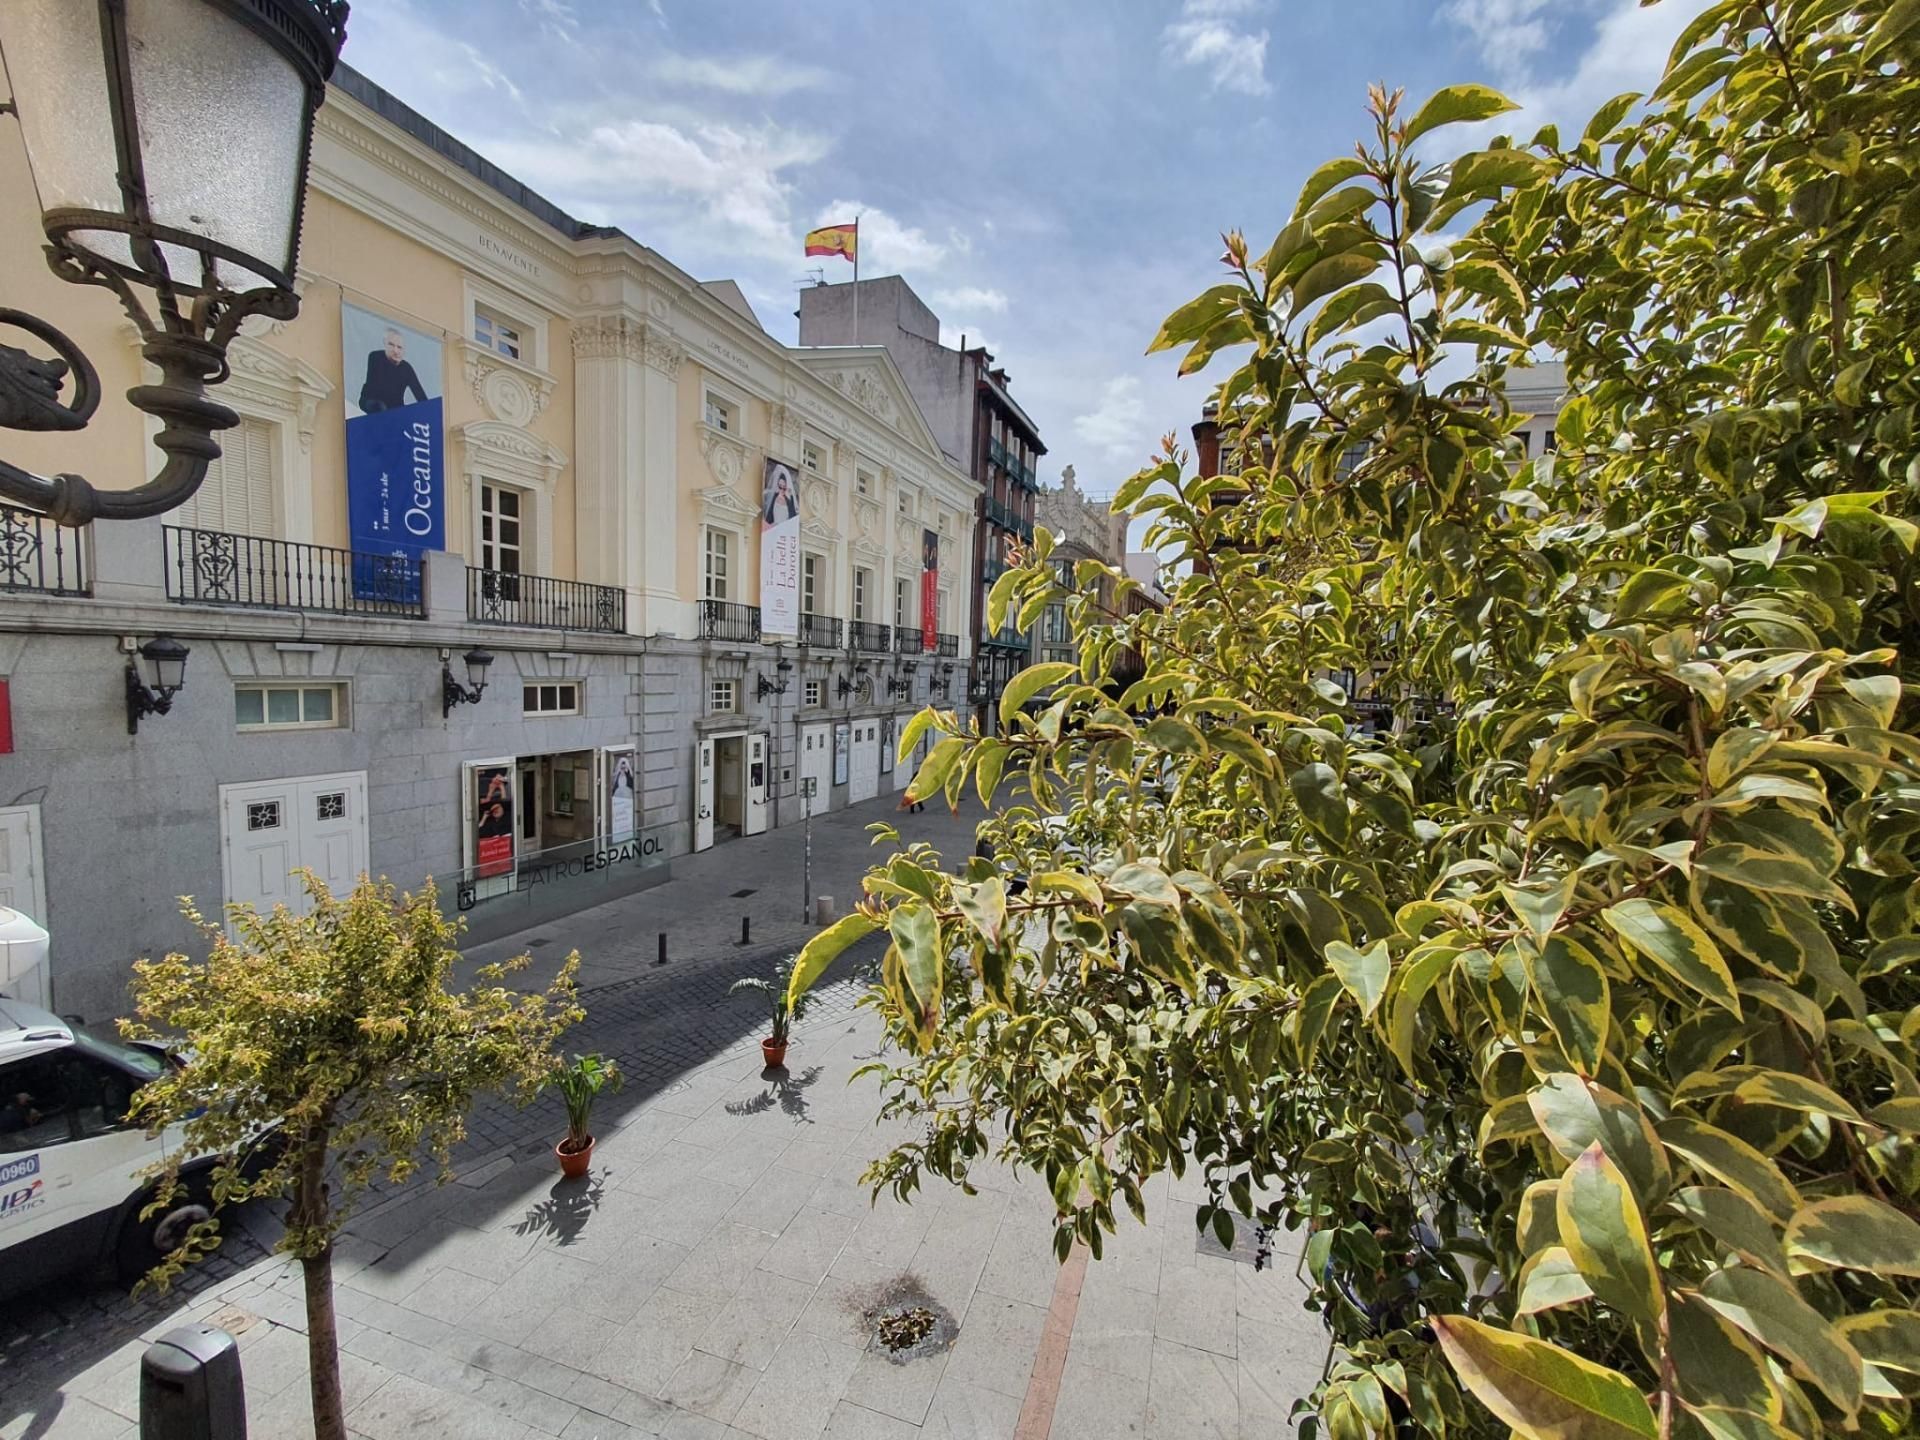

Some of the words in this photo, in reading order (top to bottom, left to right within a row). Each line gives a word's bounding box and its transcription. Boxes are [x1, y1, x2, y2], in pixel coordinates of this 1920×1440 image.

[479, 235, 540, 277] BENAVENTE
[379, 471, 389, 487] abr
[404, 422, 432, 536] Oceanía
[776, 535, 787, 566] bella
[787, 535, 797, 589] Dorotea
[777, 571, 787, 588] La
[0, 1159, 36, 1182] 0960
[0, 1199, 45, 1219] GISTICS
